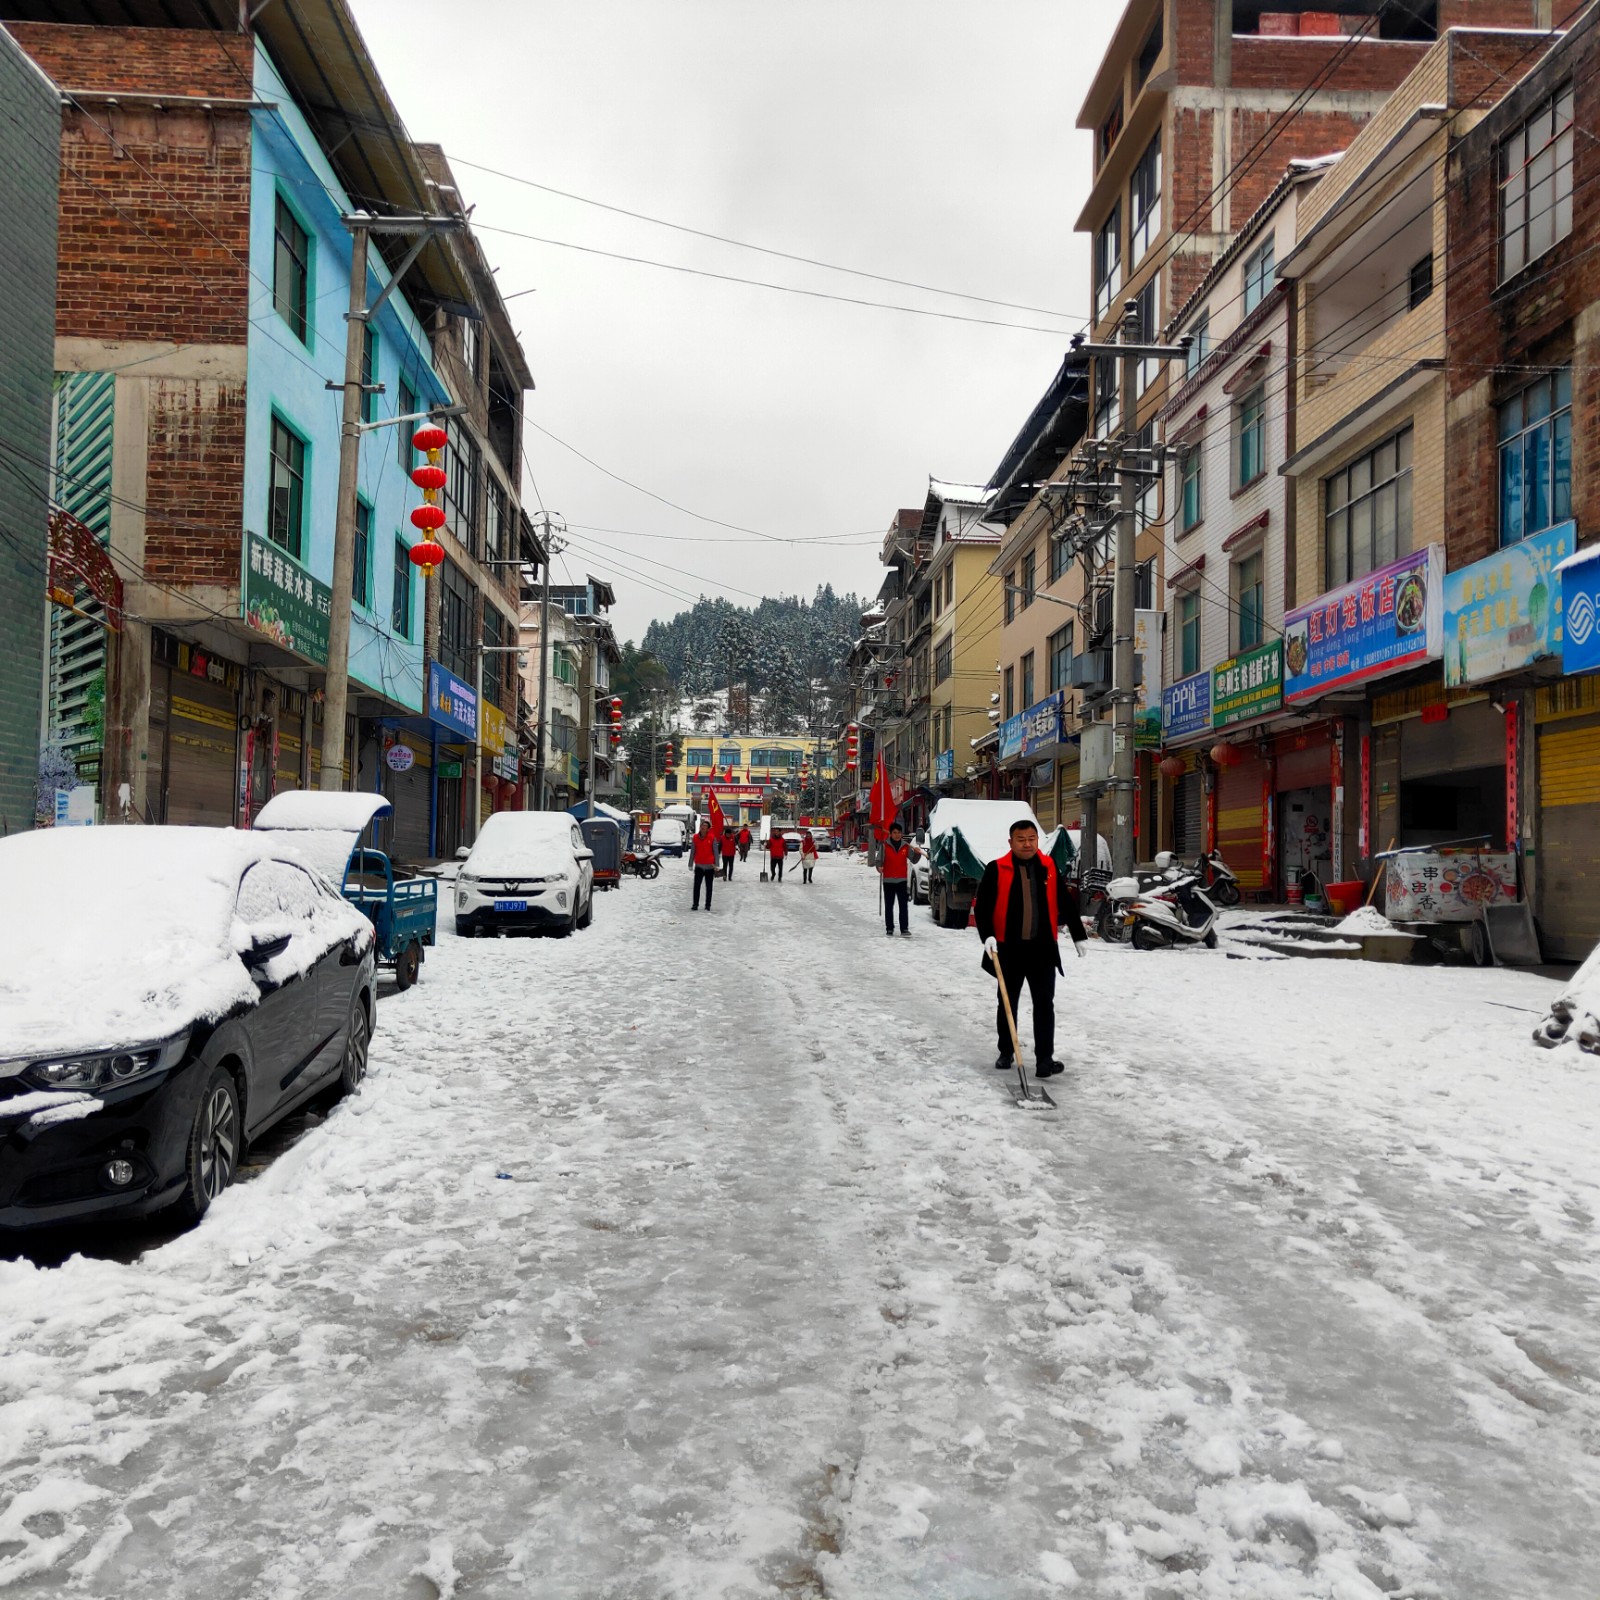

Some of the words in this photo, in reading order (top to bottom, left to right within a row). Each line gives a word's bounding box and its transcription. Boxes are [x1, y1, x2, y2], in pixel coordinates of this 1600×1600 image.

[251, 539, 313, 607] 新鲜蔬菜水果
[1309, 575, 1395, 645] 红灯笼饭店
[1172, 682, 1197, 716] 户户达
